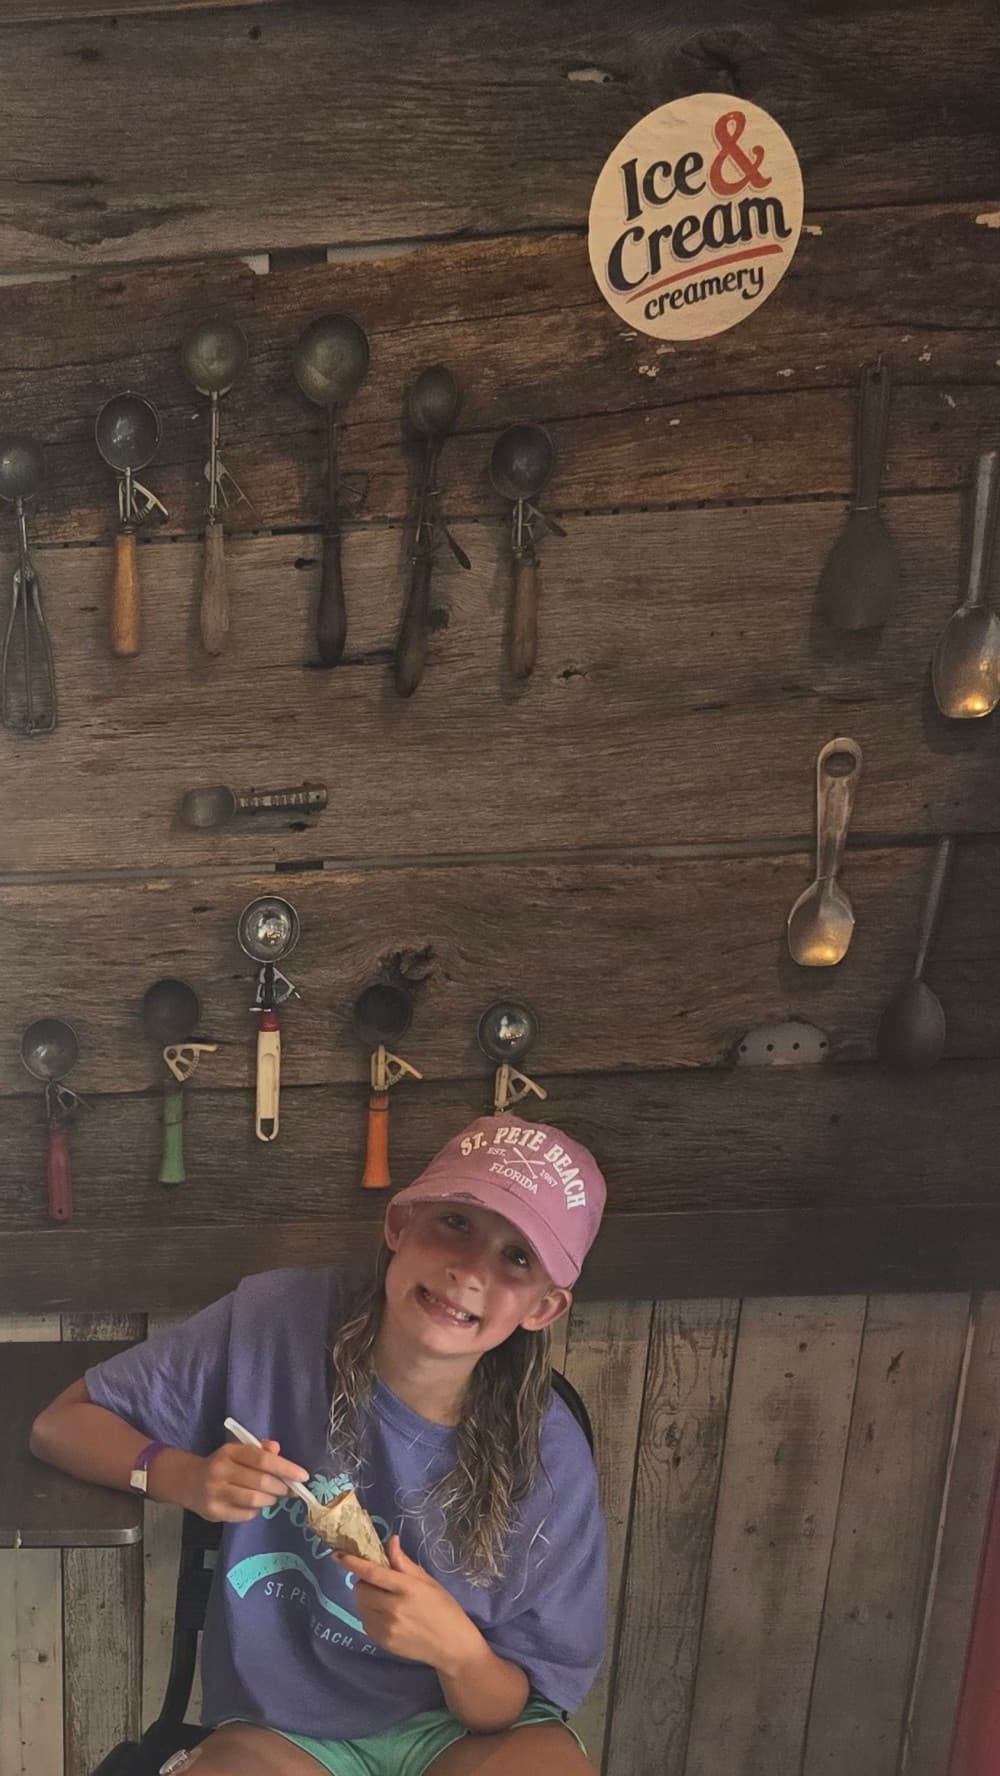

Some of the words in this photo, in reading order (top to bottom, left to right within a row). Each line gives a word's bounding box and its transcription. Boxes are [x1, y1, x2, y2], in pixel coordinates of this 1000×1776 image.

[620, 151, 706, 221] Ice
[607, 196, 793, 292] Cream
[644, 265, 765, 321] creamery
[460, 1131, 488, 1156] ST.
[493, 1126, 547, 1151] PETE
[543, 1143, 587, 1210] BEACH
[487, 1146, 507, 1157] EST.
[488, 1162, 539, 1195] FLORIDA
[263, 1581, 285, 1599] ST.
